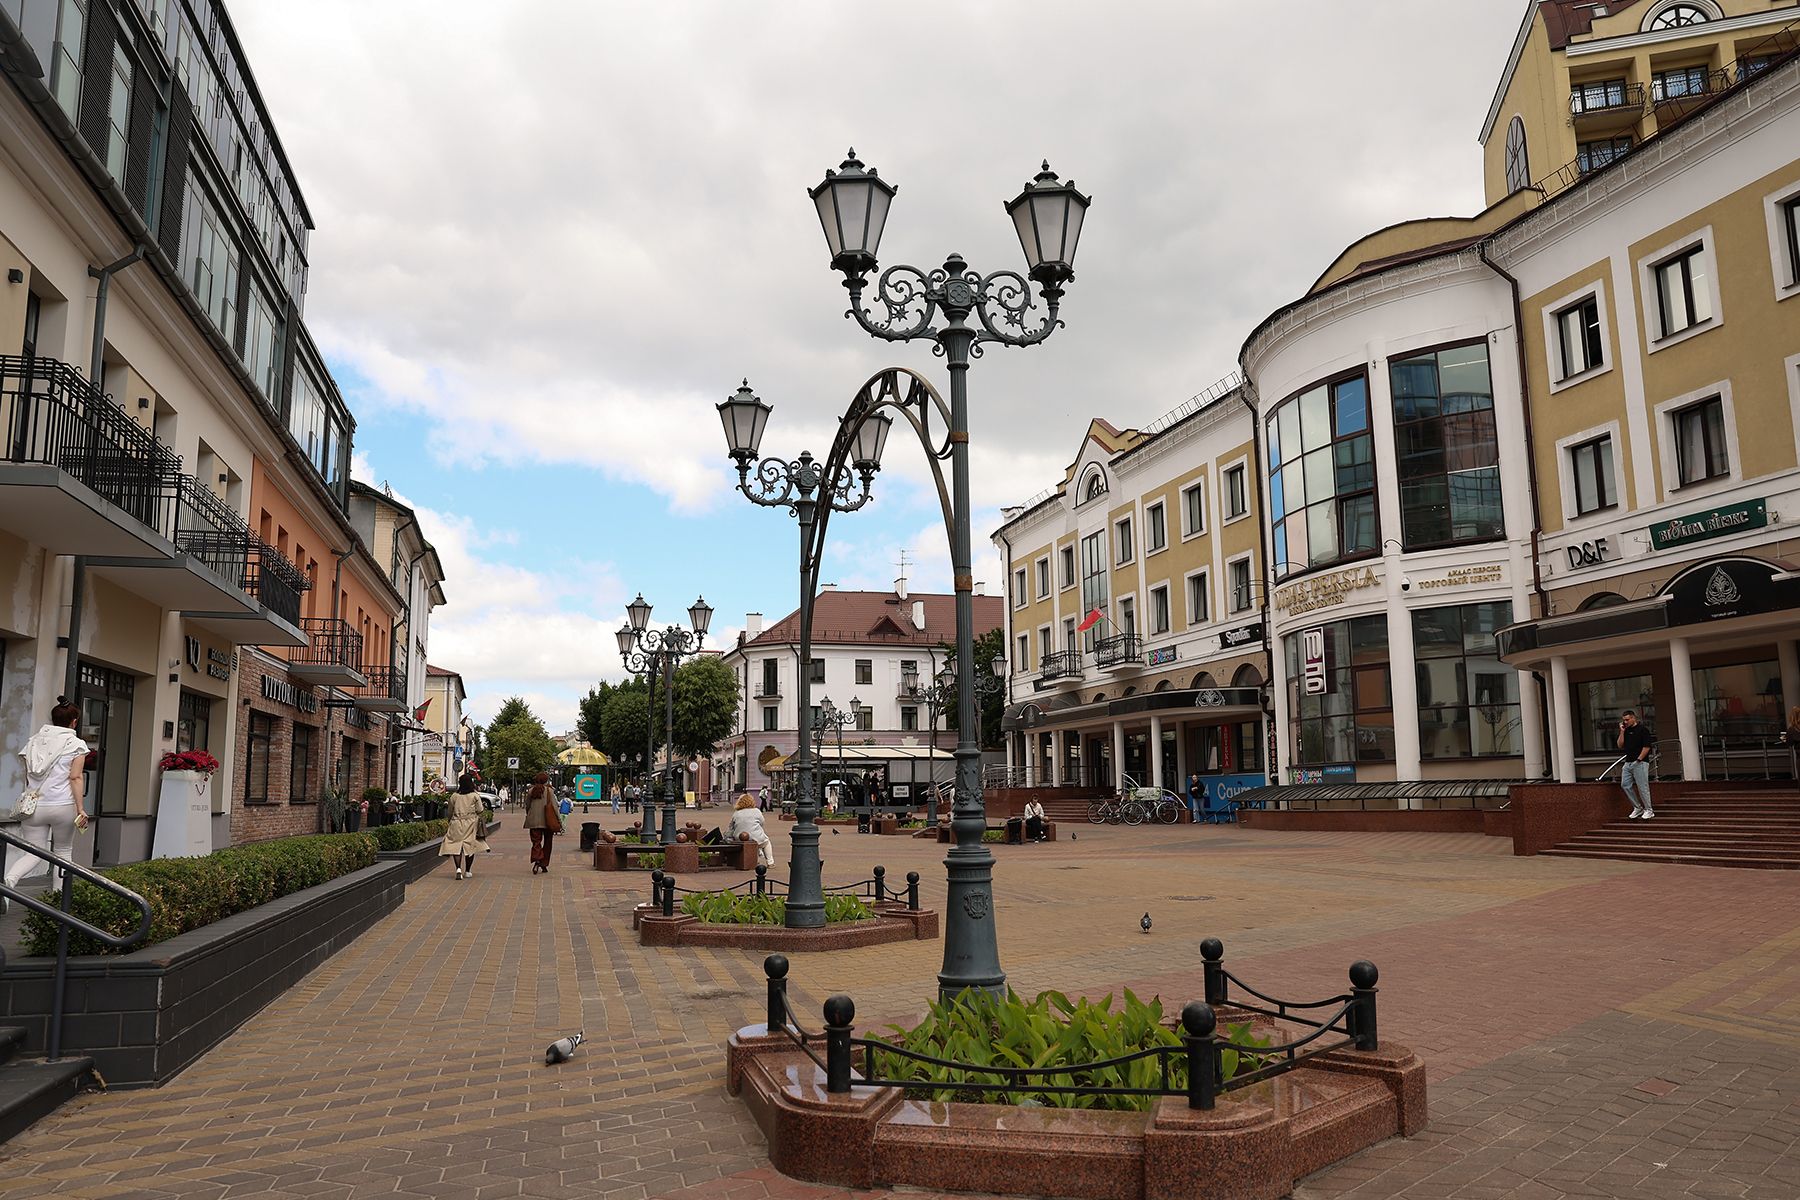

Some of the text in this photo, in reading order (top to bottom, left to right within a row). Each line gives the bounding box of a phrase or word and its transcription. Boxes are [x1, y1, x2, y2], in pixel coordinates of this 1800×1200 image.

[1567, 538, 1609, 567] D&F
[1311, 566, 1381, 598] PERSIA
[1418, 573, 1502, 589] ТОРГОВЫЙ ЦЕНТР
[264, 674, 298, 707] VITTORIA
